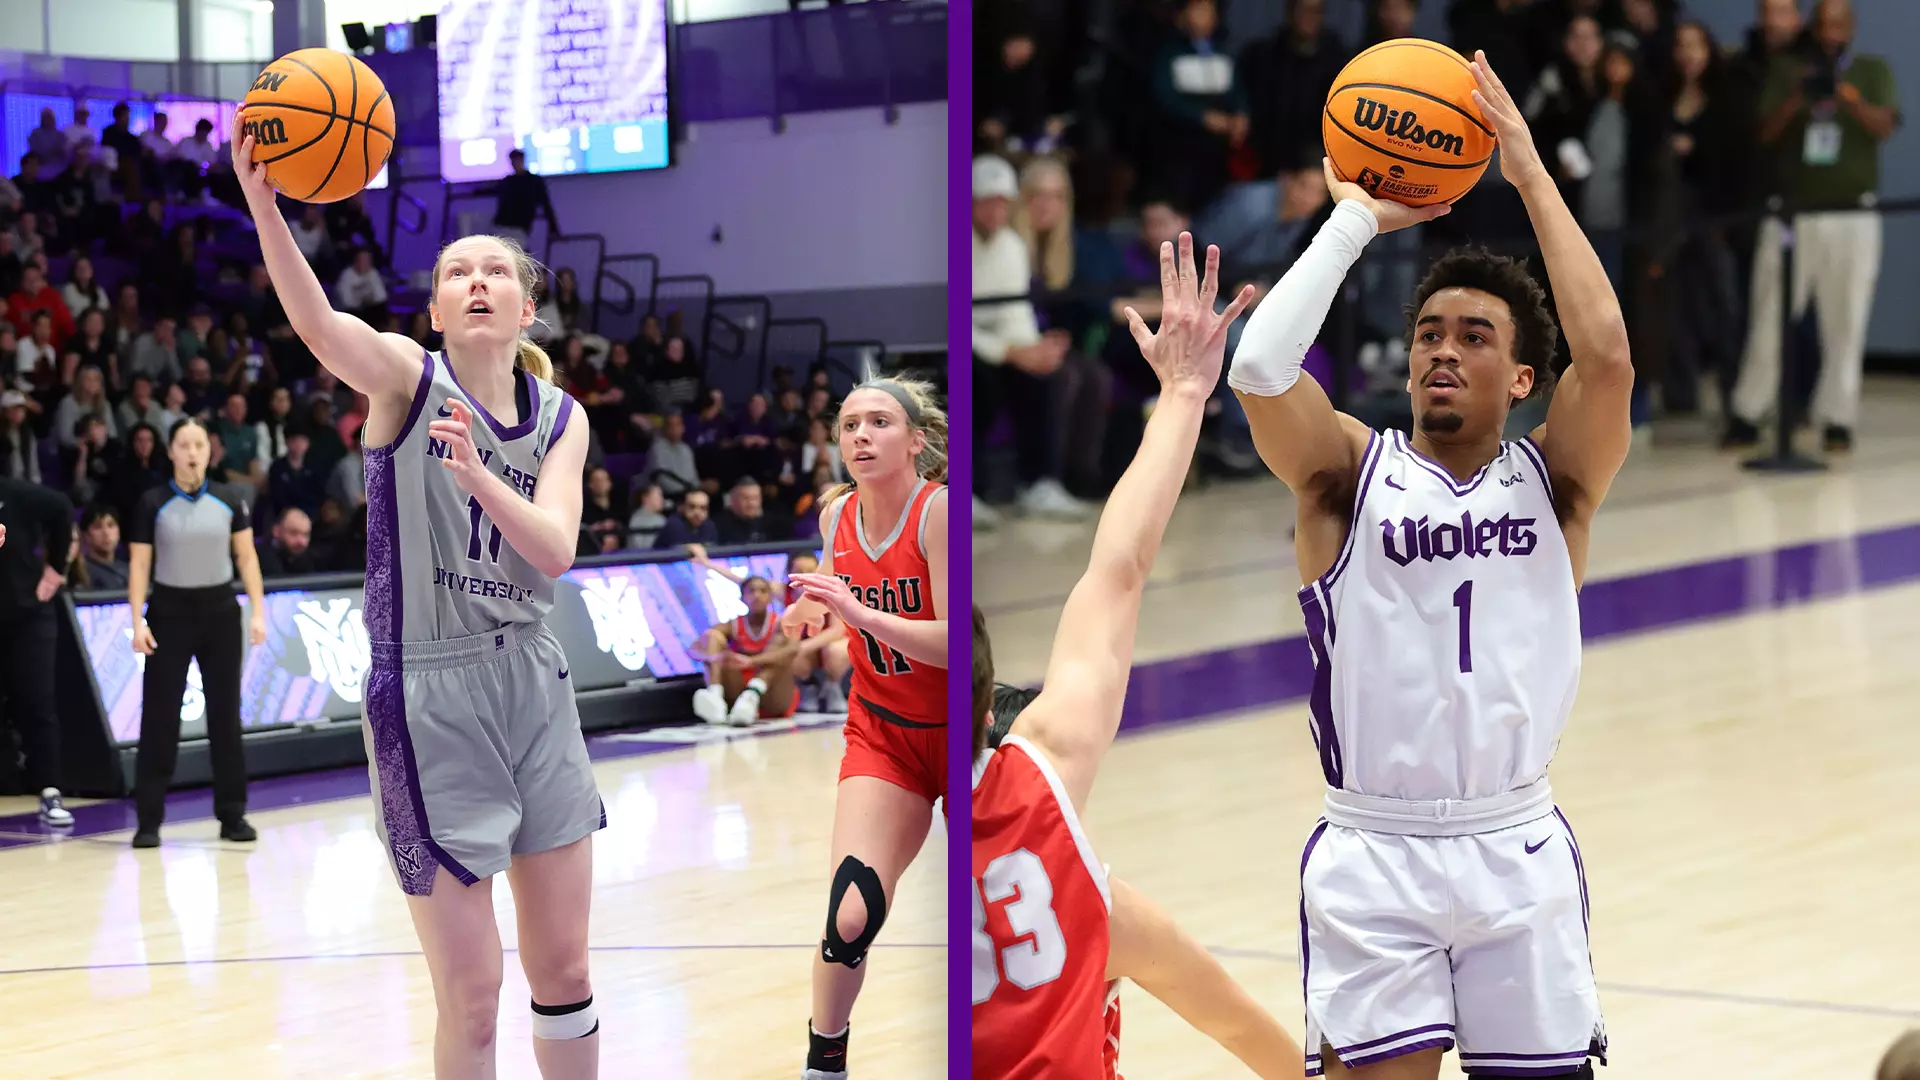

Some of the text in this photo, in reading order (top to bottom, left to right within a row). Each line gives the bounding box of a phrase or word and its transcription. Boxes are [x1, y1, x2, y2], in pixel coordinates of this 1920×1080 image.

[1354, 96, 1464, 157] Wilson
[1387, 138, 1423, 153] EVO NXT
[1381, 186, 1428, 199] CHAMPIONSHIP
[1383, 180, 1438, 195] BASKETBALL
[1379, 510, 1538, 567] Violets
[1453, 580, 1473, 673] 1
